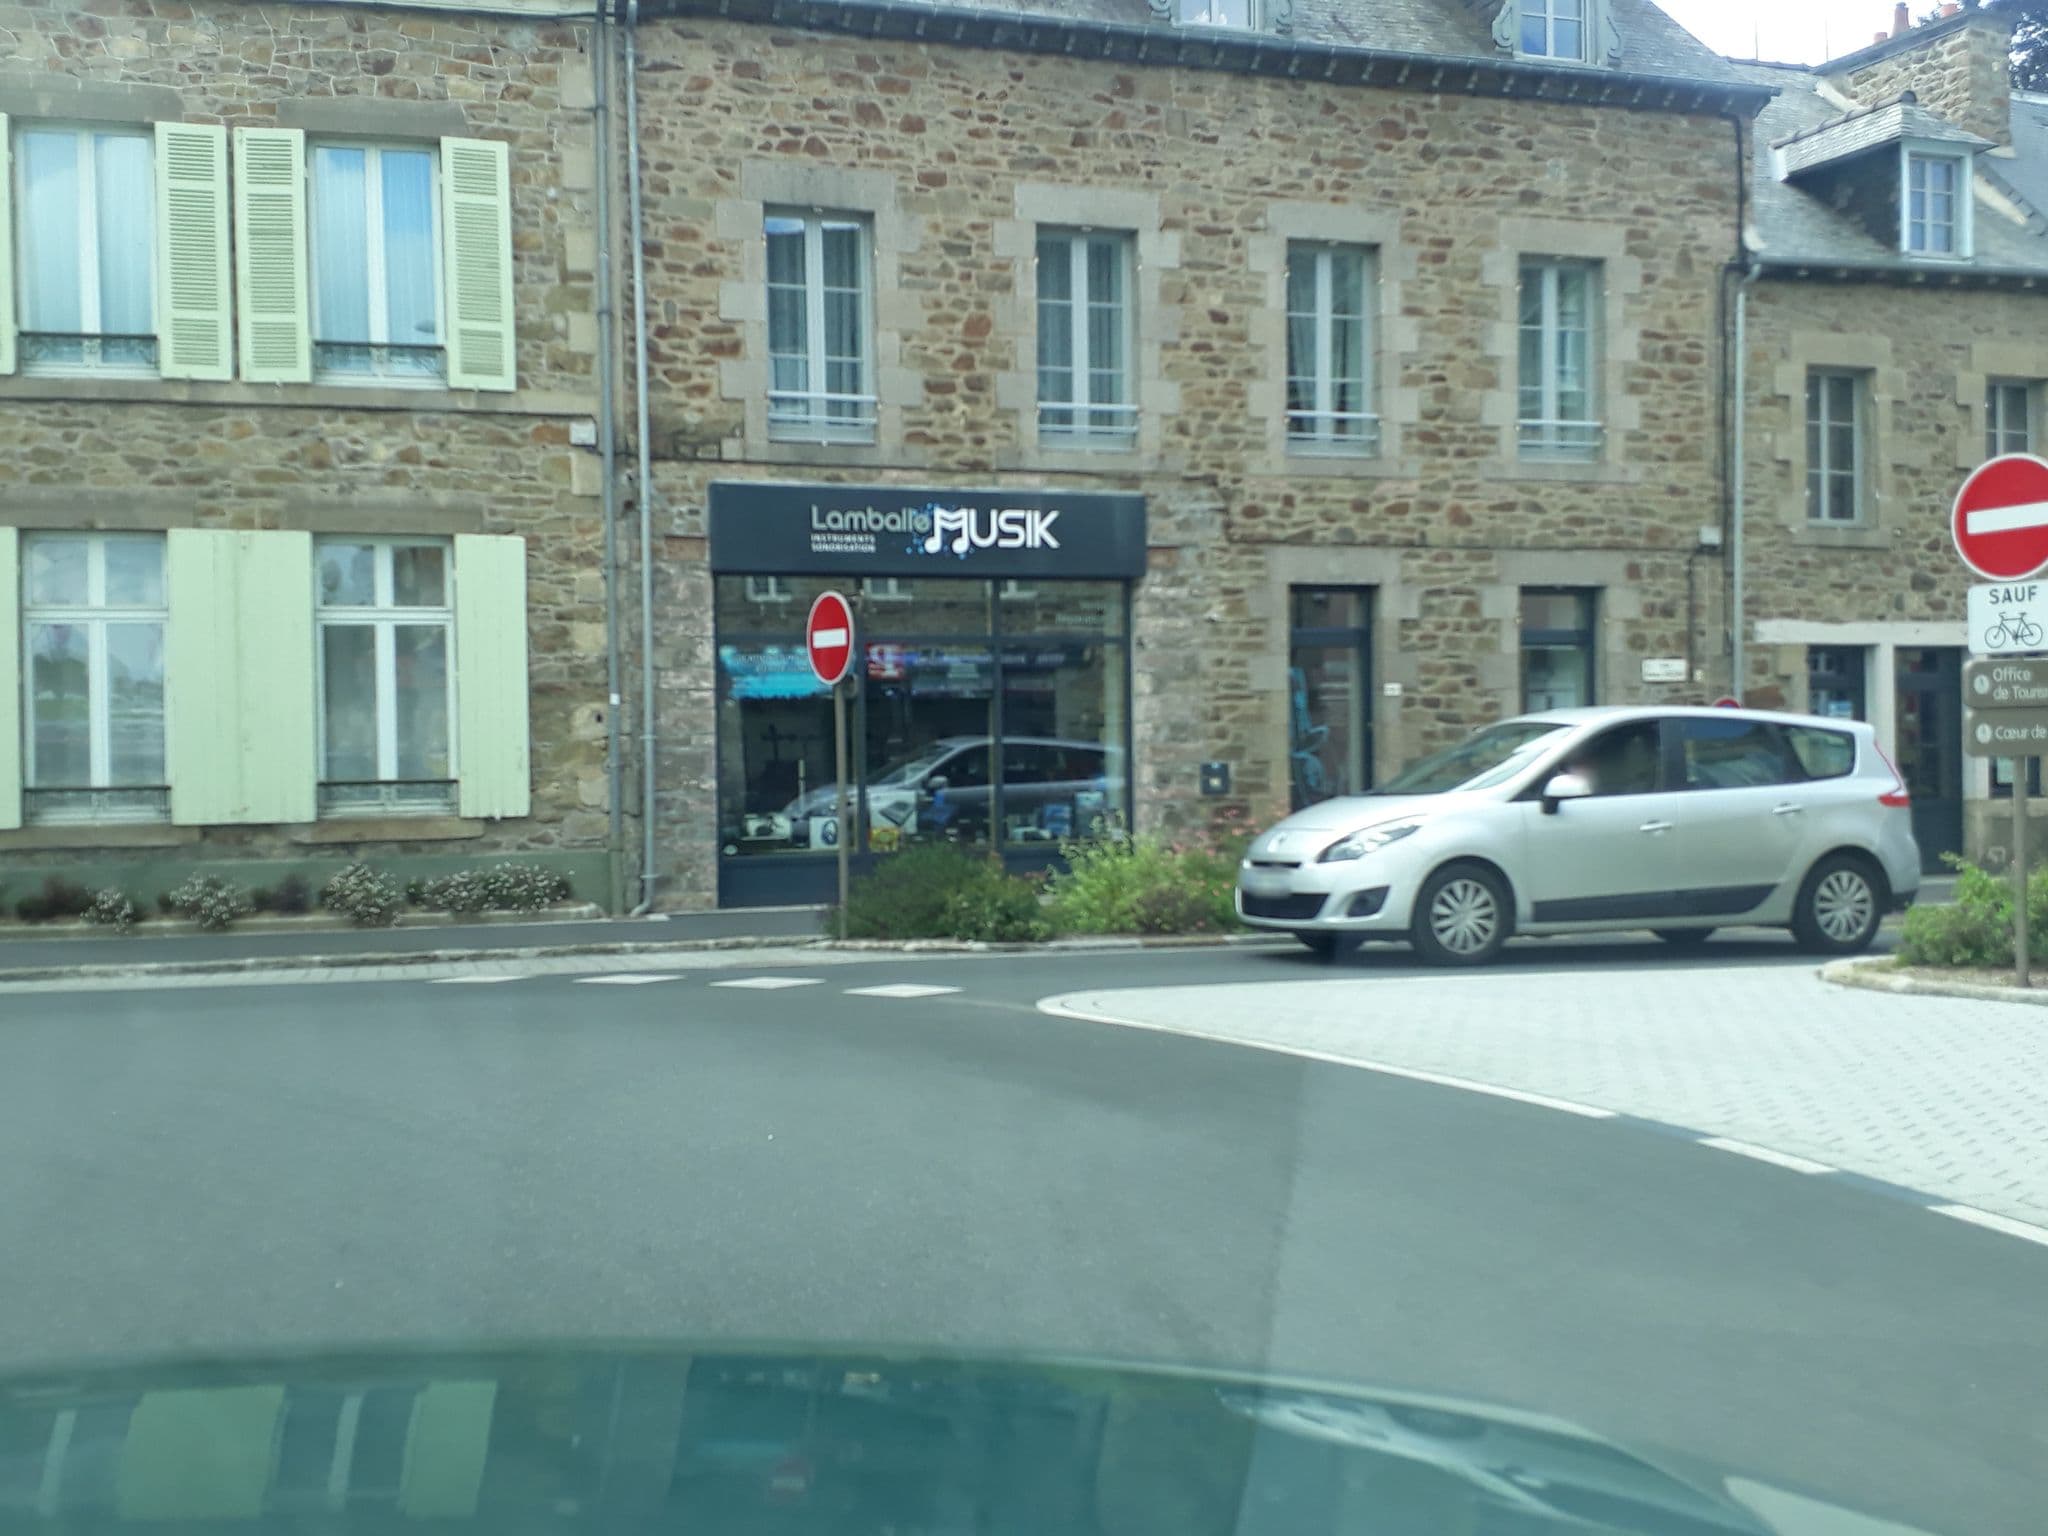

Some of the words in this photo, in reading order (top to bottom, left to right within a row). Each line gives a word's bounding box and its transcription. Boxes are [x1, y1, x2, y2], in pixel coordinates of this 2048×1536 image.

[811, 505, 932, 533] Lamballe
[924, 506, 1061, 554] MUSIK
[1989, 585, 2038, 604] SAUF
[1993, 667, 2032, 682] Office
[1993, 685, 2009, 700] de
[2031, 723, 2048, 740] de
